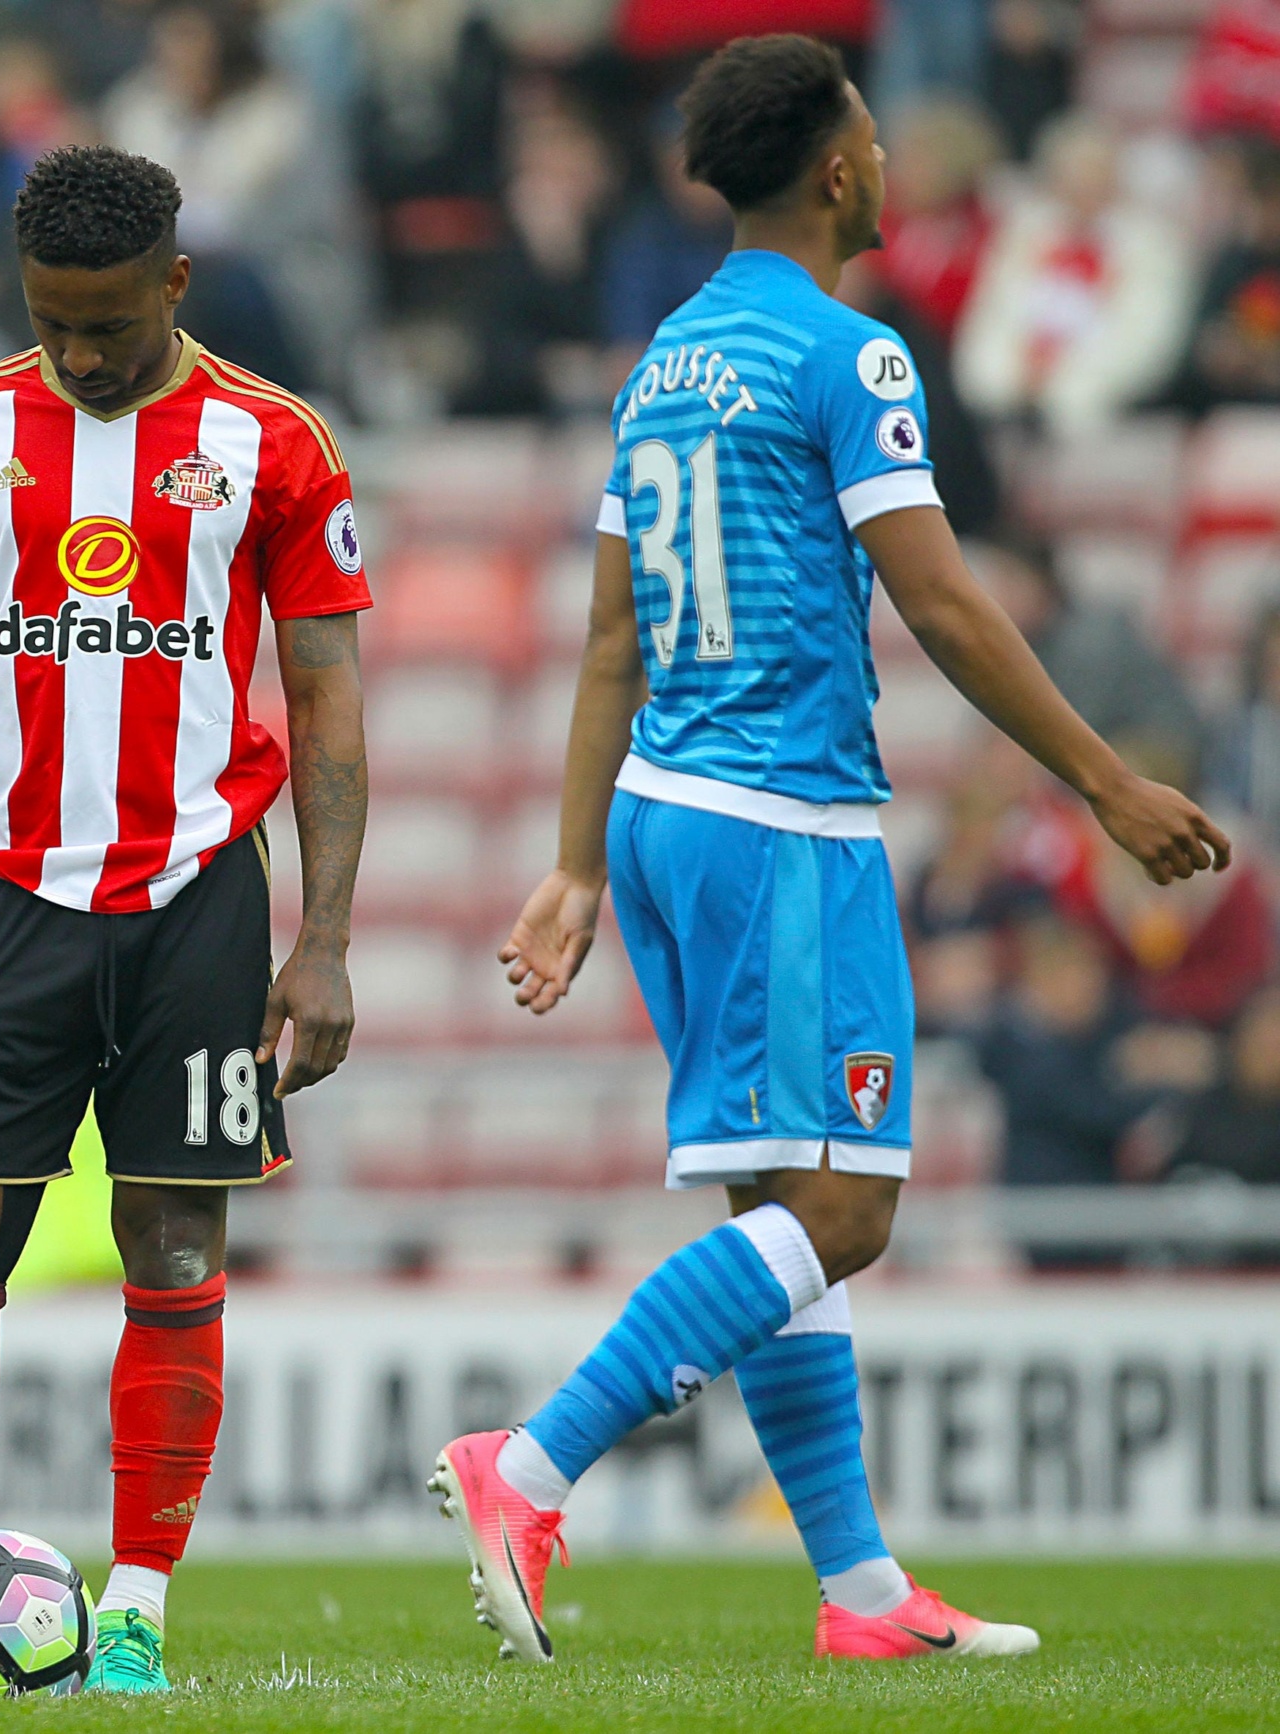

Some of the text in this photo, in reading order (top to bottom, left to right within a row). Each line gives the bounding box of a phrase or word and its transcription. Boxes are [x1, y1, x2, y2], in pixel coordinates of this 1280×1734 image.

[619, 344, 758, 443] MOUSSET
[874, 355, 907, 384] JD
[630, 430, 733, 668] 31
[184, 1048, 259, 1145] 18
[694, 1358, 1280, 1520] CTERPIL
[152, 1513, 193, 1523] adid
[41, 1609, 53, 1624] FIFA
